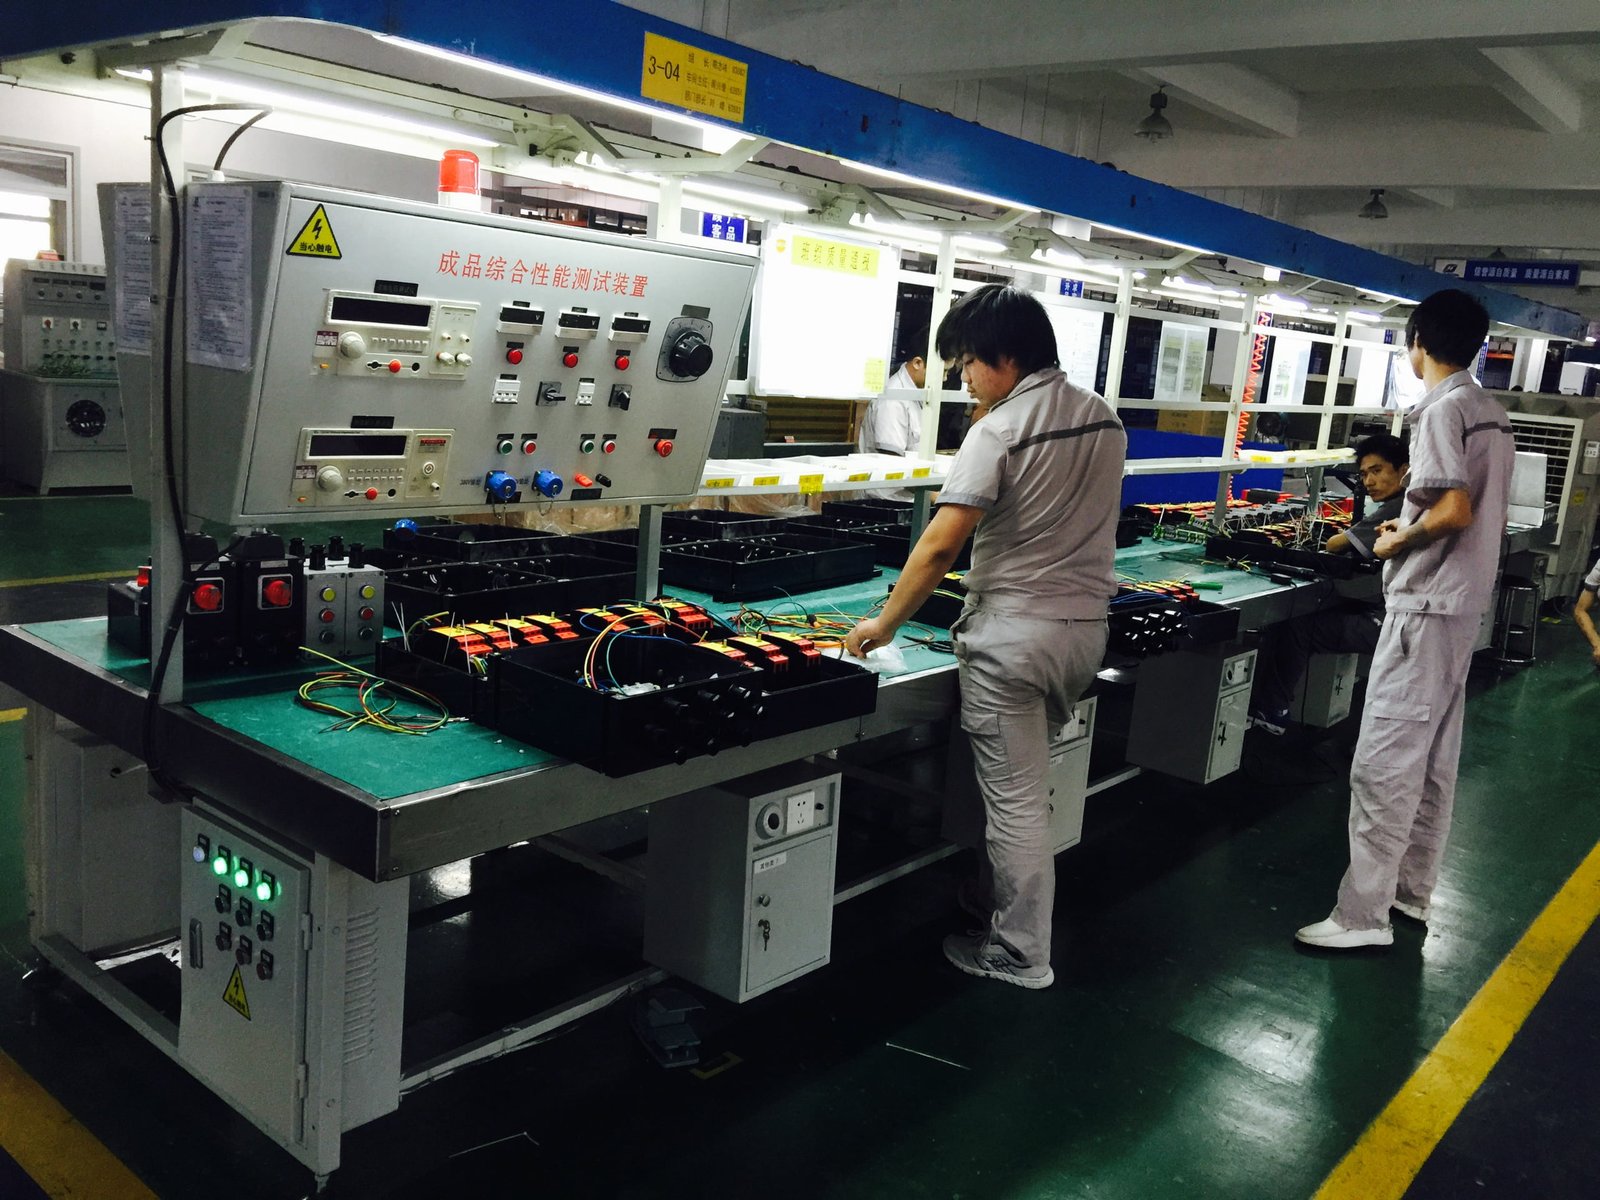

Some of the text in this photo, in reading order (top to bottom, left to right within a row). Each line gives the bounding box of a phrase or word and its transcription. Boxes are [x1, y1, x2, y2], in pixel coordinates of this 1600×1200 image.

[648, 56, 680, 82] 3-04
[300, 242, 332, 253] 当心触电
[436, 250, 648, 298] 成品综合性能测试装置
